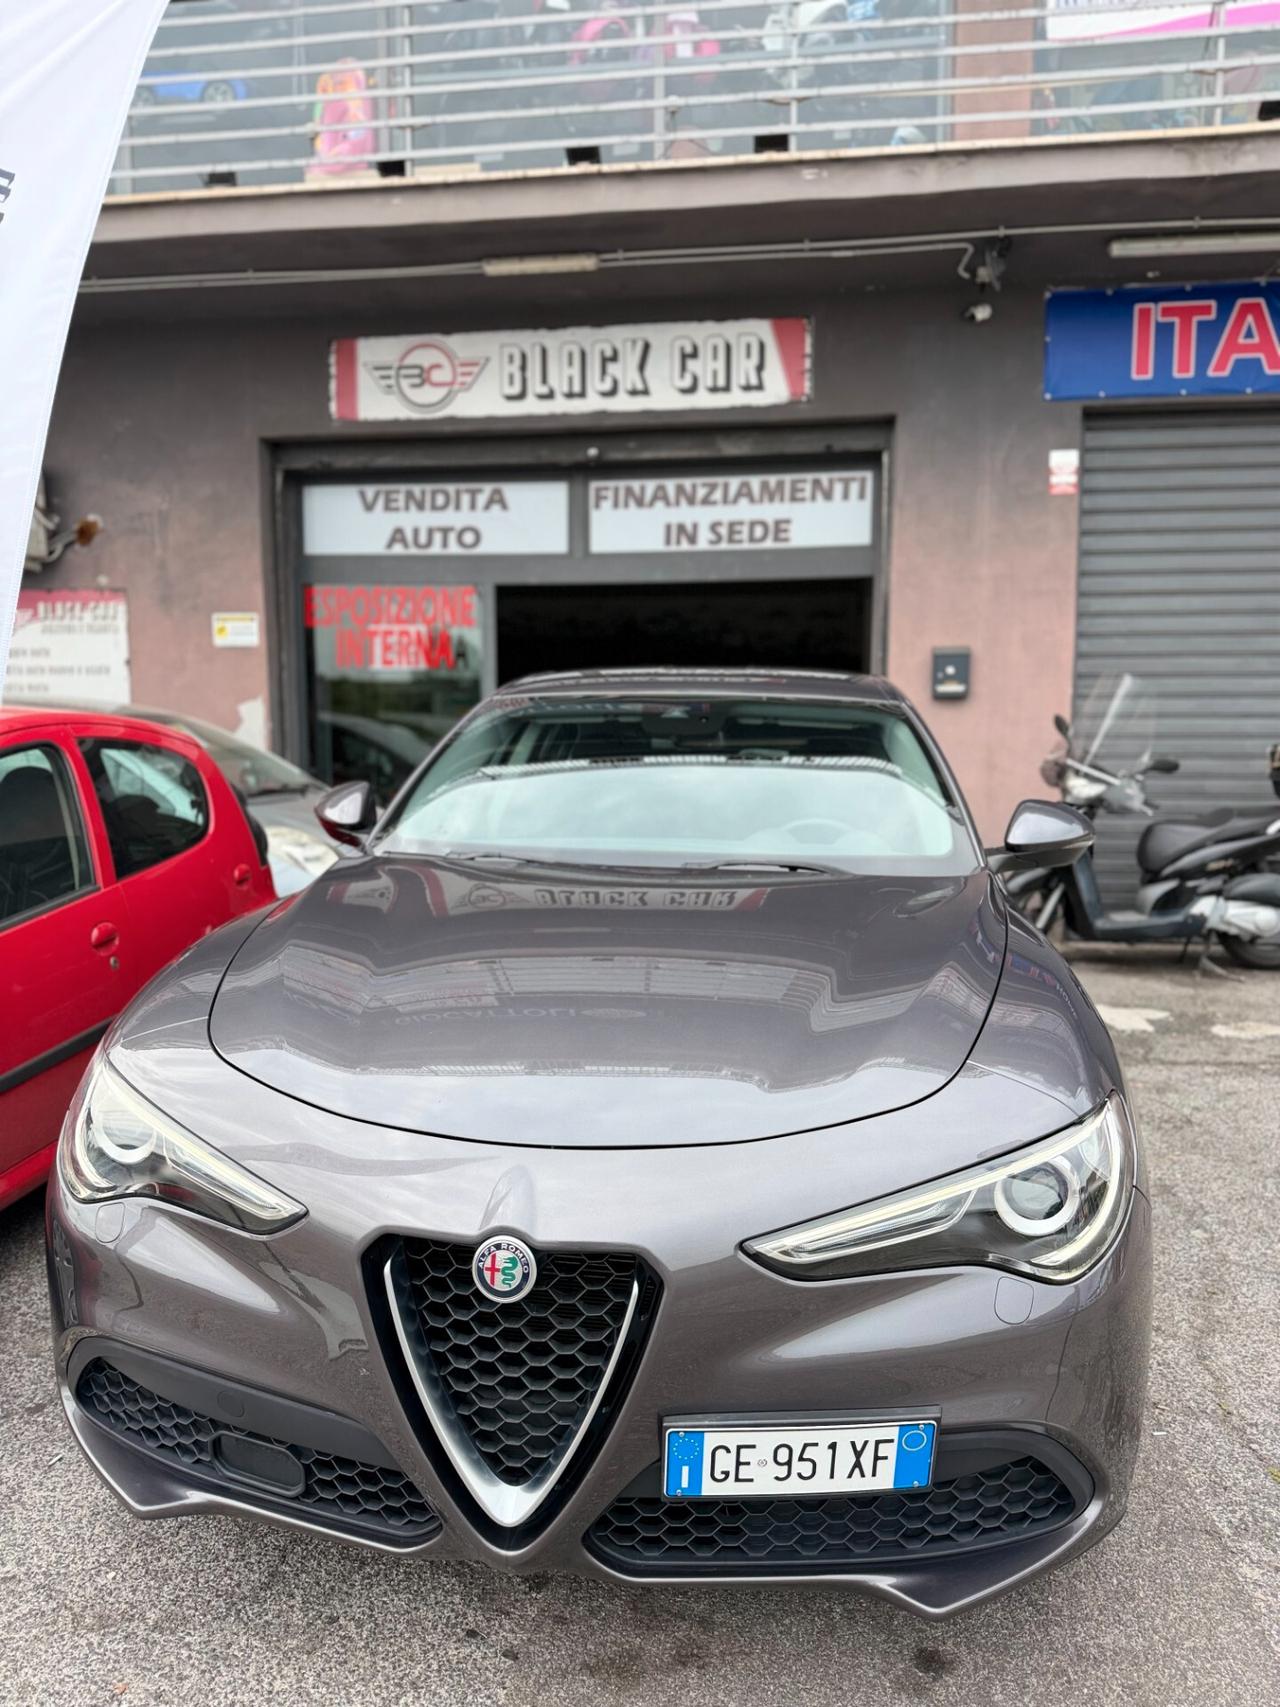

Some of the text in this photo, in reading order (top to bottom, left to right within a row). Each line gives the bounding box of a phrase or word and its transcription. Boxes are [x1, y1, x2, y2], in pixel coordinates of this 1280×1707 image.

[1131, 298, 1280, 380] ITA
[502, 333, 764, 400] BLACK CAR
[358, 488, 508, 512] VENDITA
[593, 476, 868, 510] FINANZIAMENTI
[386, 526, 482, 550] AUTO
[664, 519, 791, 546] IN SEDE
[304, 585, 478, 629] ESPOSIZIONE
[335, 628, 456, 670] INTERNA
[478, 1243, 529, 1273] ALFA ROMEO
